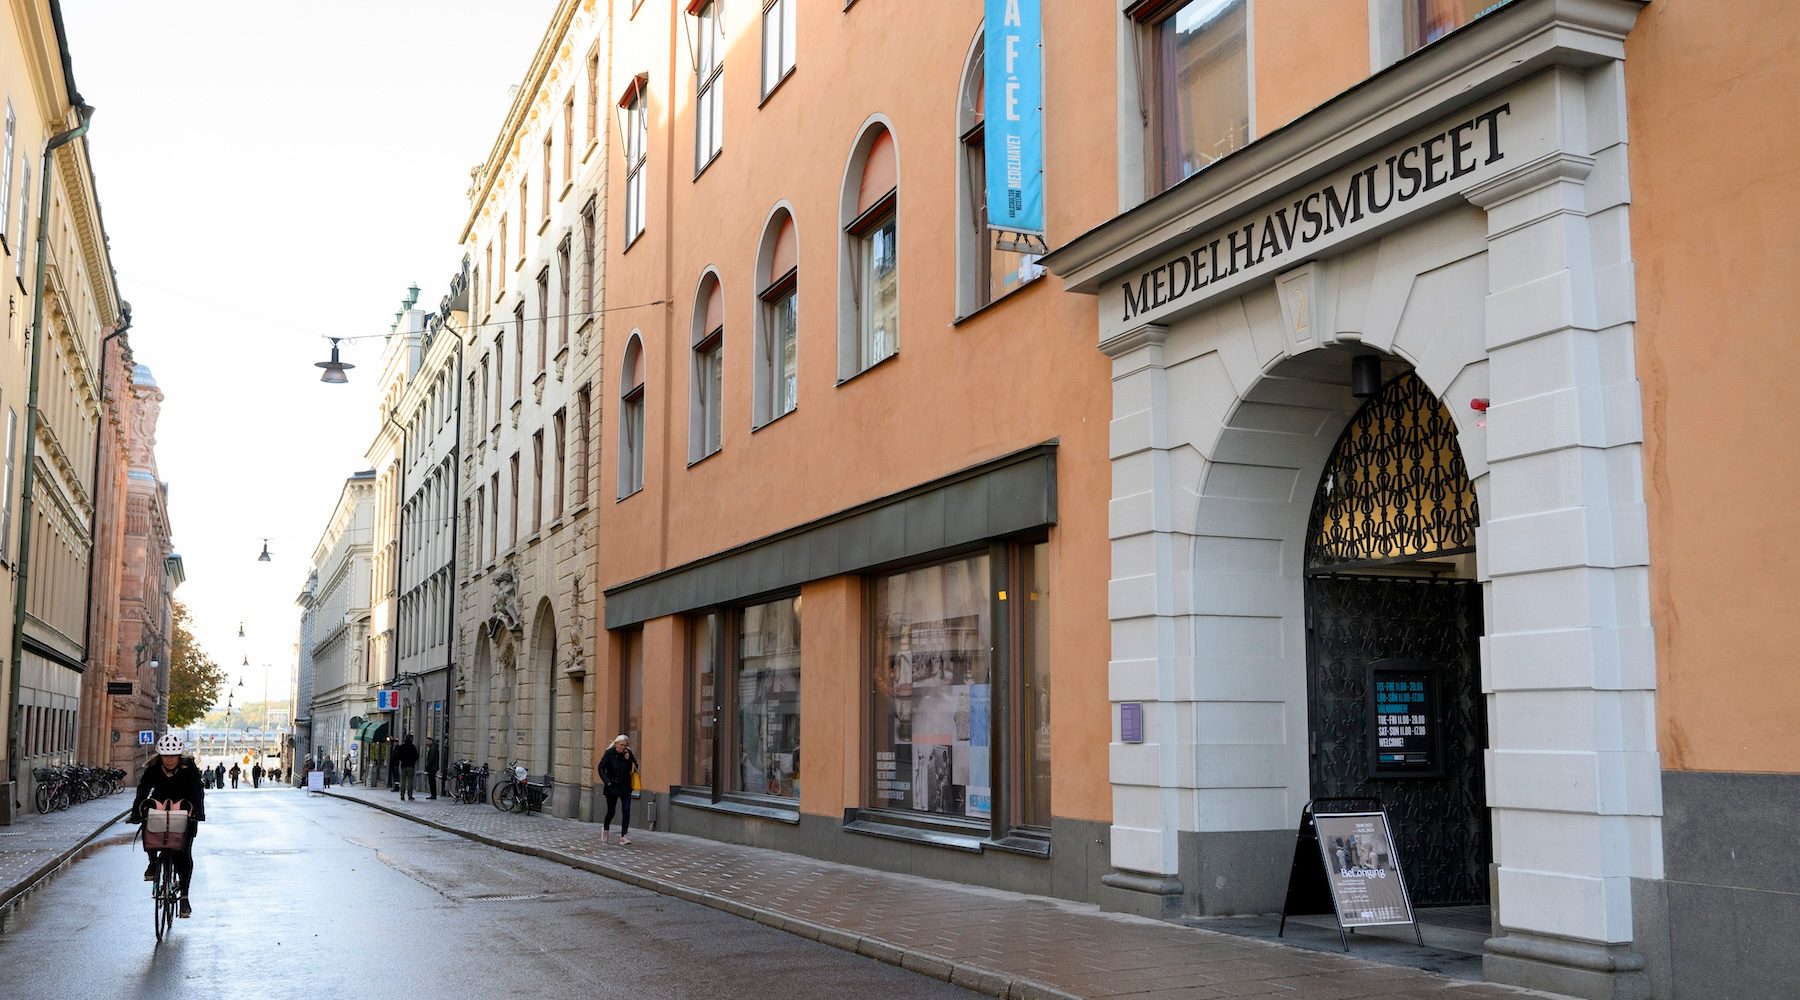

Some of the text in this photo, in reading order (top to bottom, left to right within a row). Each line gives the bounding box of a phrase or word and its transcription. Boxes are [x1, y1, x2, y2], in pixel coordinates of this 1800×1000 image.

[1007, 134, 1021, 189] MEDELHAVET
[1122, 103, 1511, 321] MEDELHAVSMUSEET
[1292, 288, 1307, 332] 2
